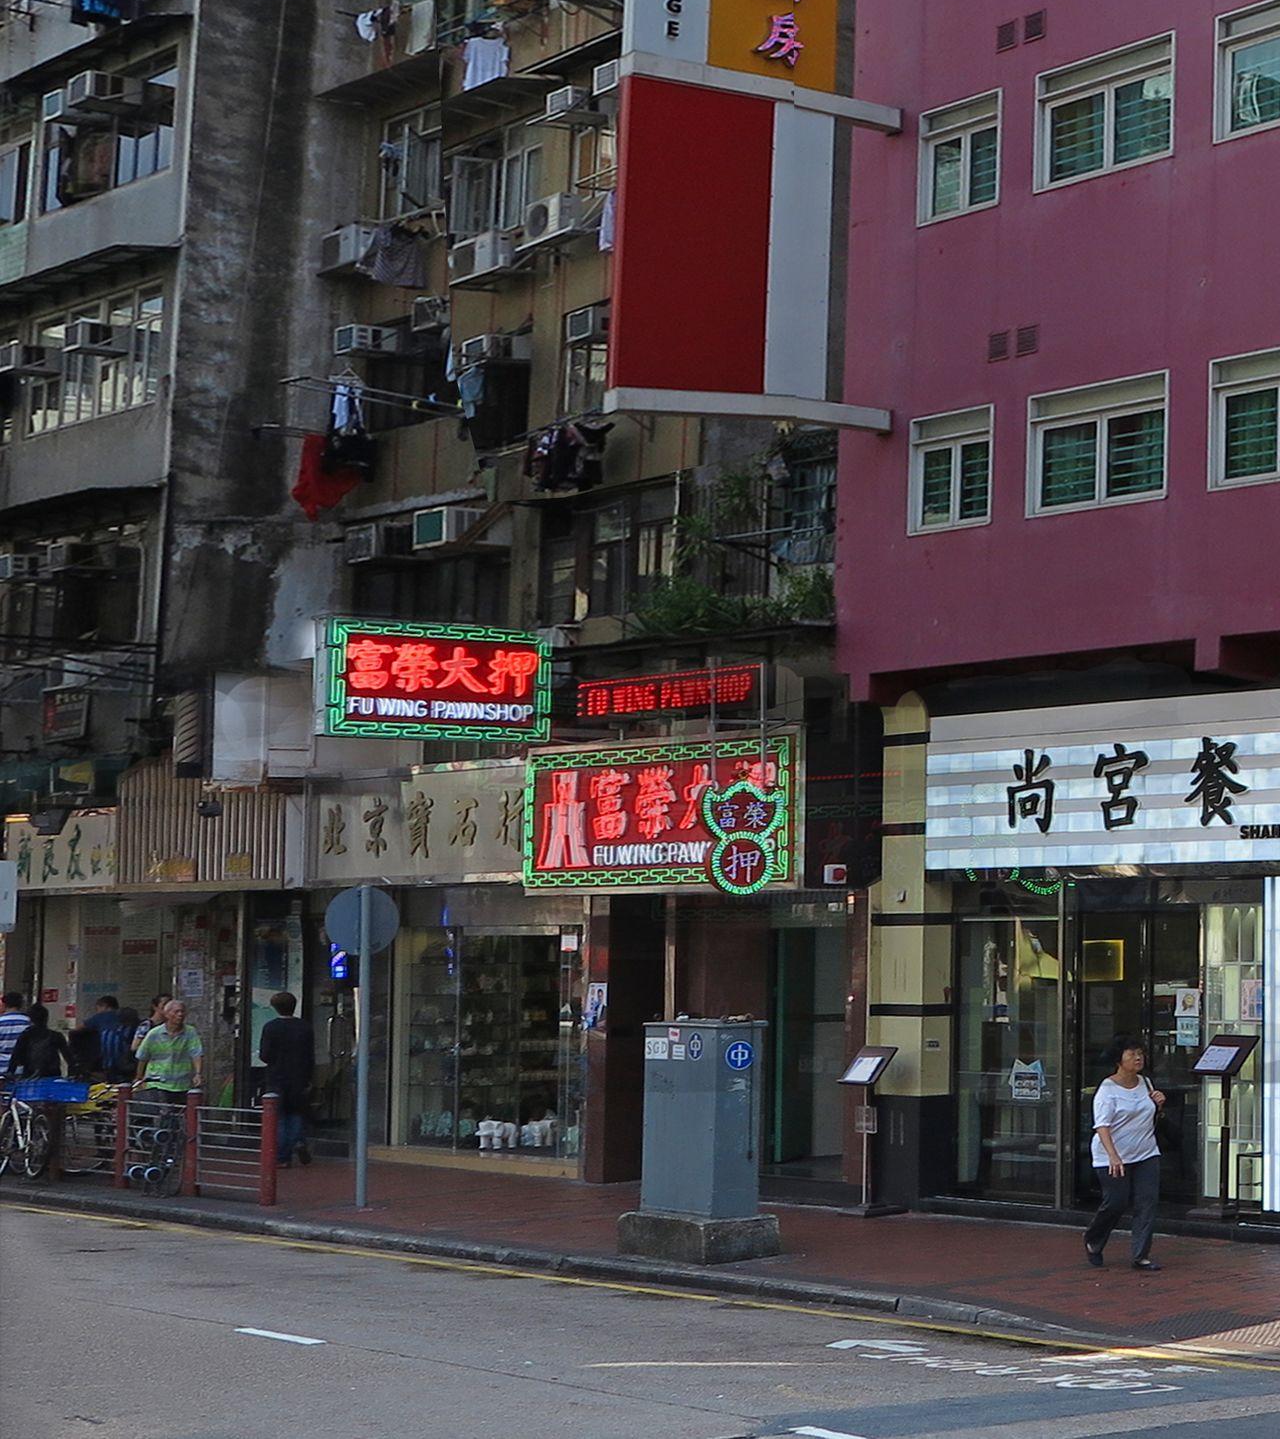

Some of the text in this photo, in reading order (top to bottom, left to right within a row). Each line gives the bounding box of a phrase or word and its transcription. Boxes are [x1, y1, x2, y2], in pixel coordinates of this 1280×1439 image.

[347, 639, 539, 698] 富榮大押
[347, 696, 534, 722] FU WING PAWNSHOP
[717, 801, 768, 830] 富榮
[723, 844, 761, 883] 押
[646, 1040, 668, 1056] SGD
[857, 1351, 1185, 1396] LOOK RIGHT
